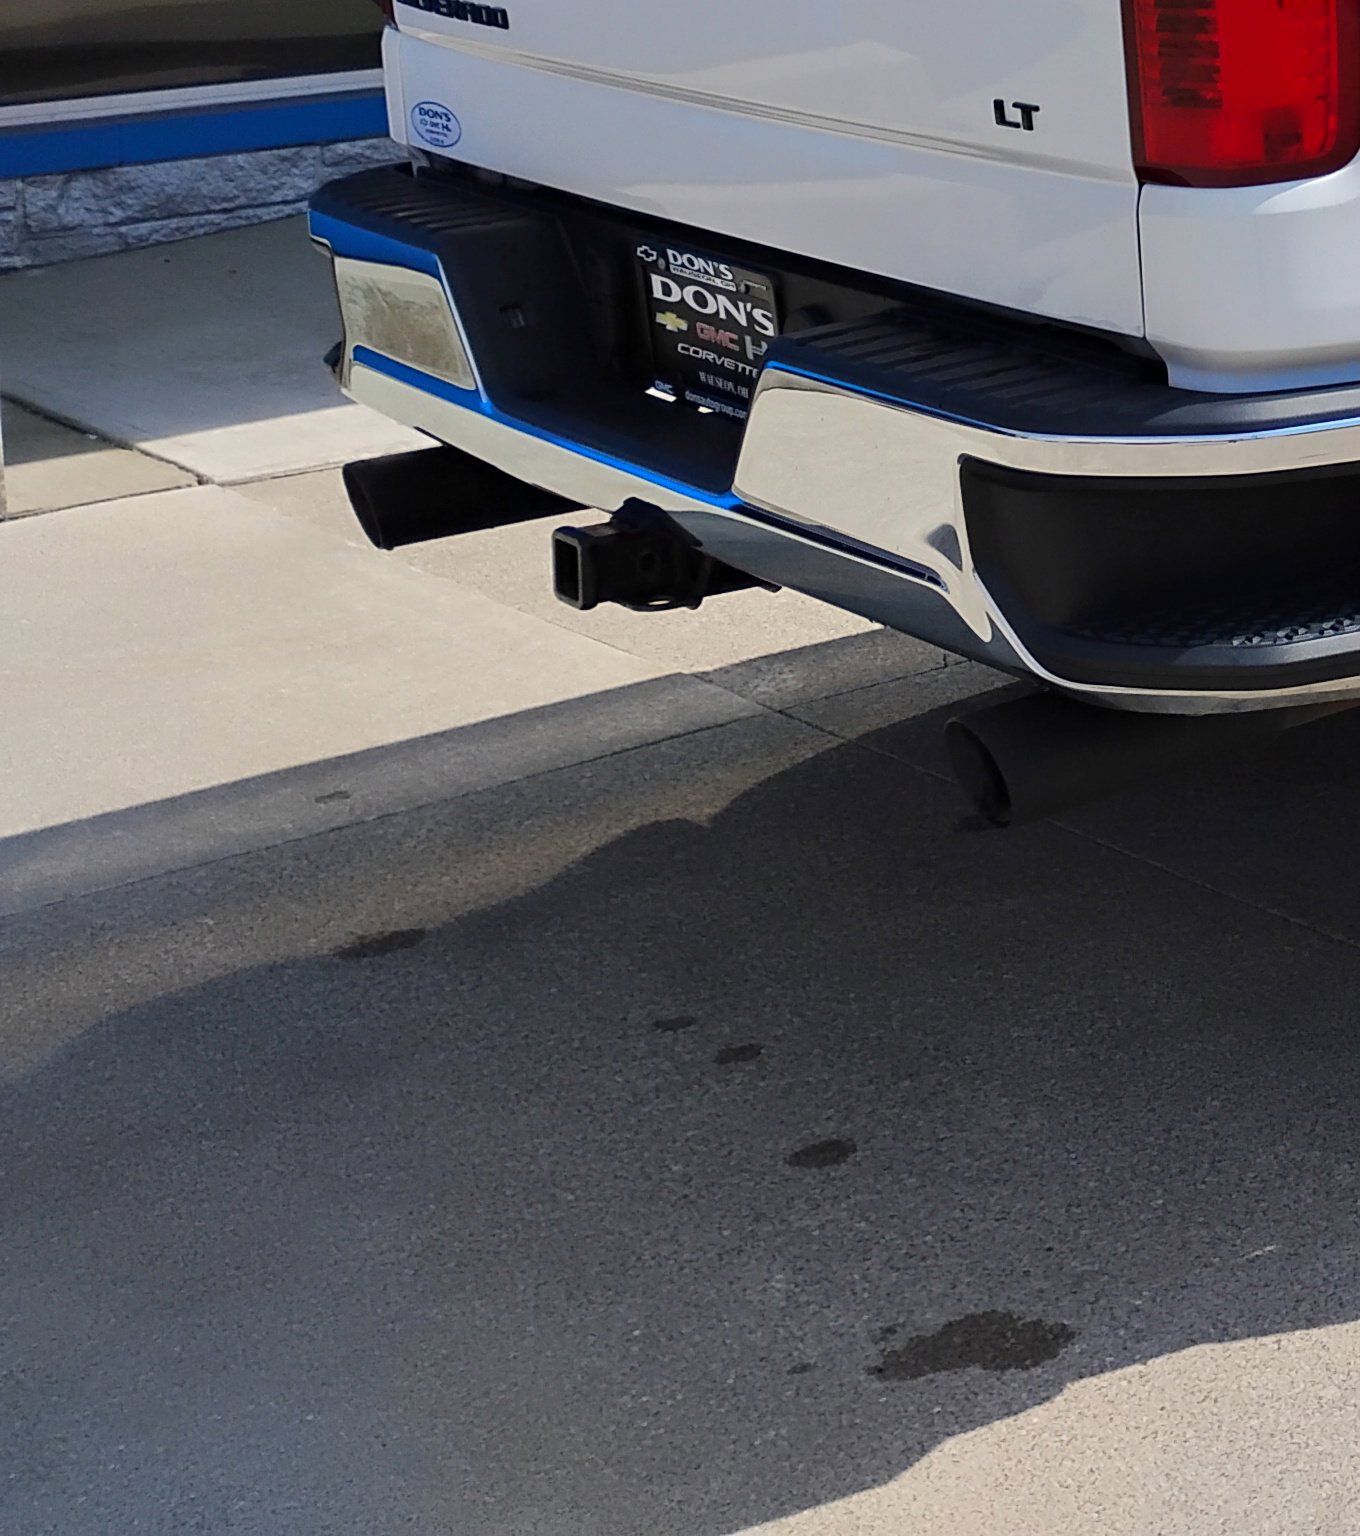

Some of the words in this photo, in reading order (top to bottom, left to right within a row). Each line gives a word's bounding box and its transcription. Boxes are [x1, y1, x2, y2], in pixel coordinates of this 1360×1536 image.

[993, 98, 1041, 131] LT
[666, 248, 734, 280] DON'S
[650, 273, 775, 337] DON'S
[695, 321, 740, 352] GMC
